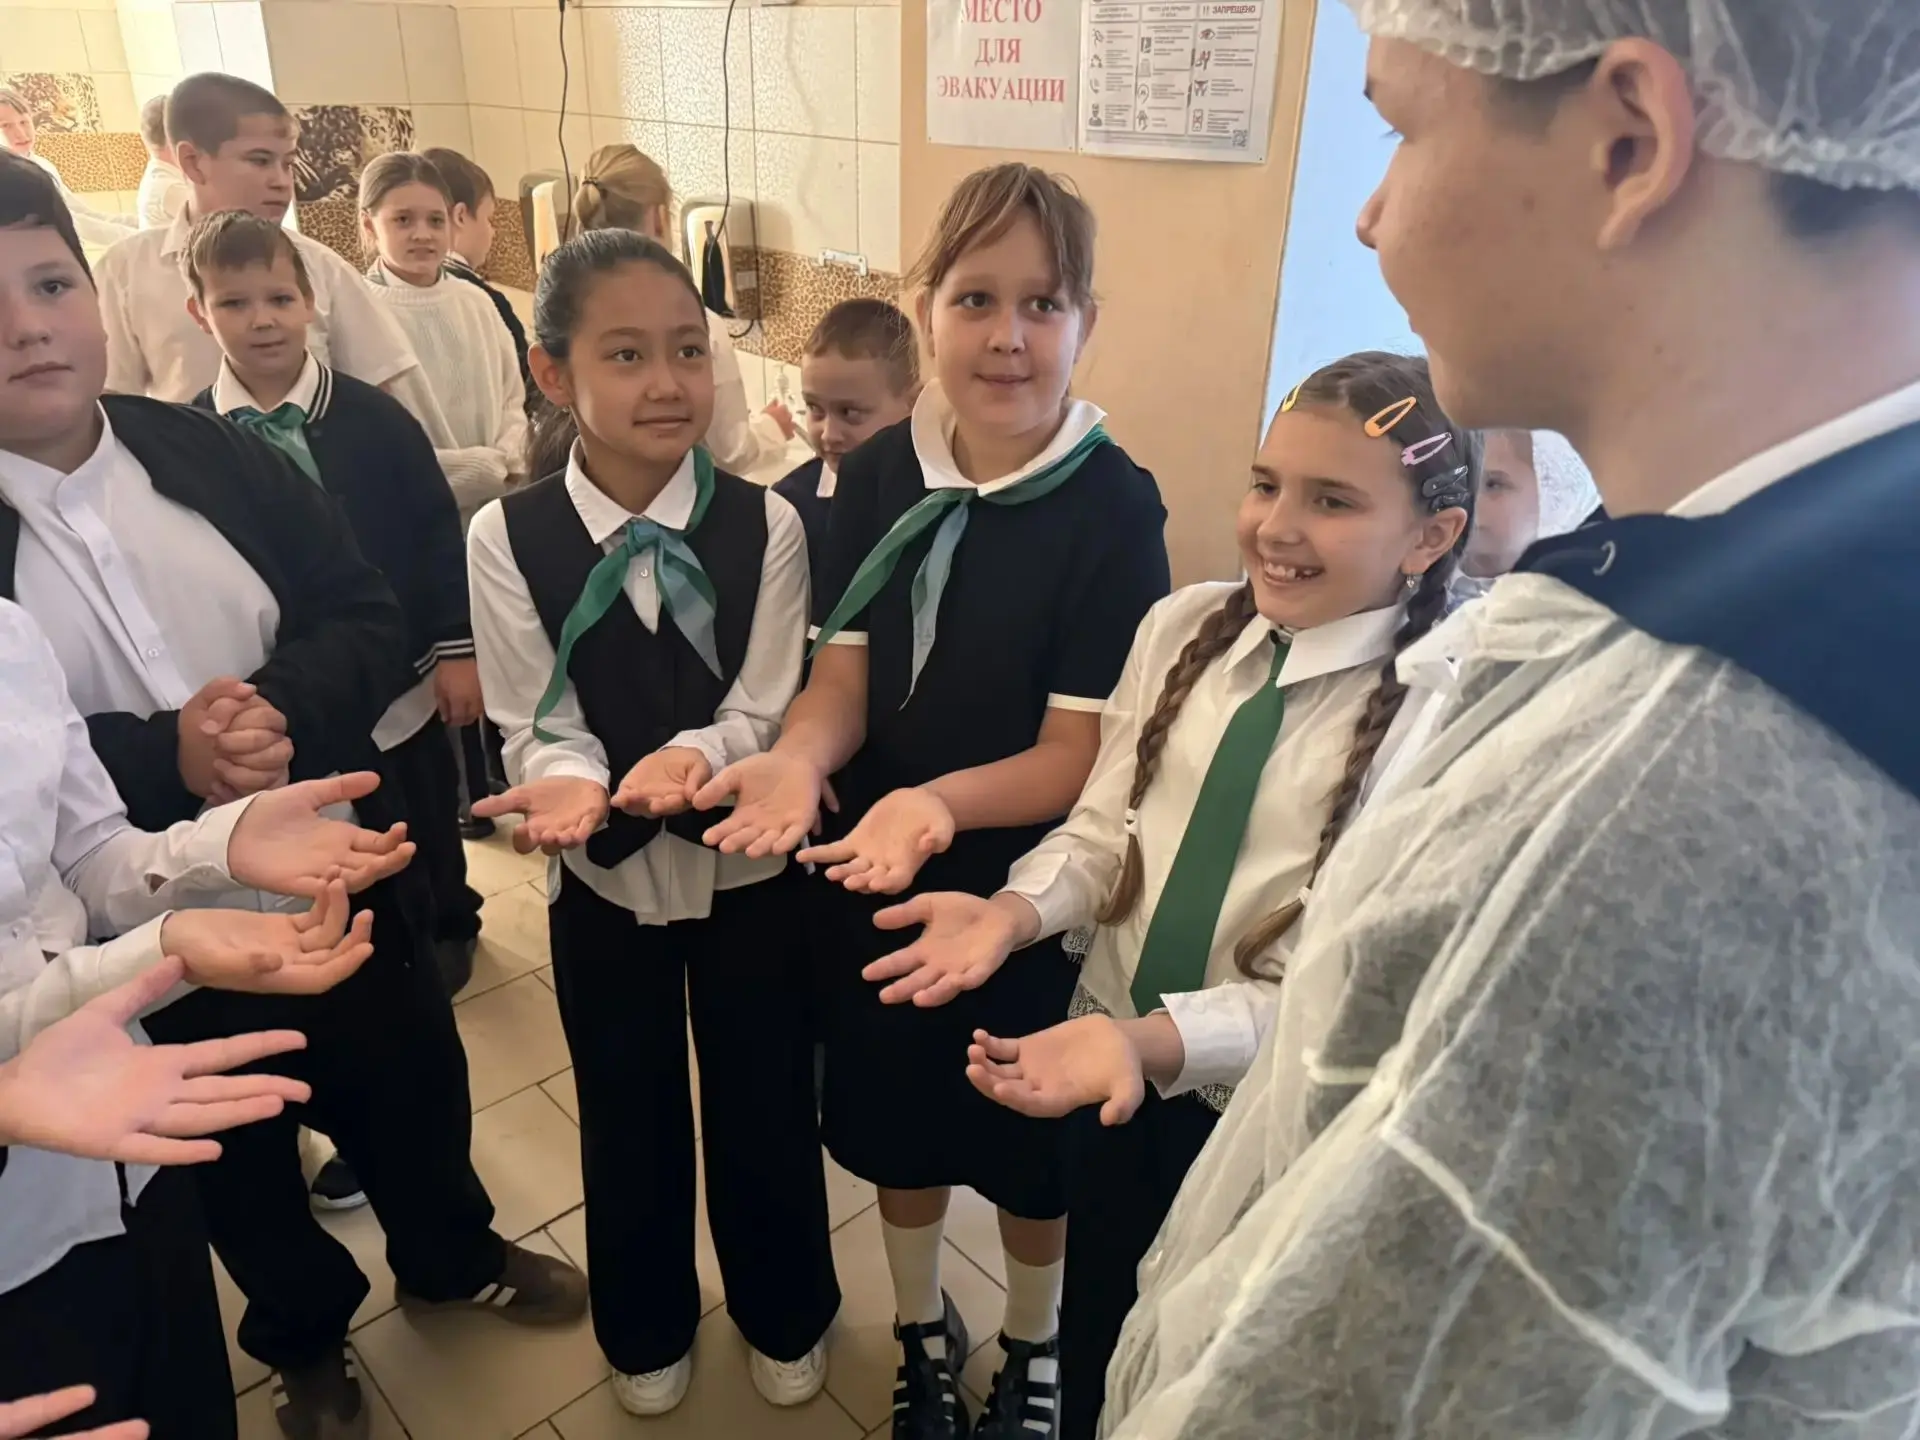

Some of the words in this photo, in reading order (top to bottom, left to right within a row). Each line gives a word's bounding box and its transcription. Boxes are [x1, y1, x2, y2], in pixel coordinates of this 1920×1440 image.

[960, 0, 1041, 23] МЕСТО
[1212, 4, 1256, 14] ЗАПРЕЩЕНО
[974, 38, 1022, 67] ДЛЯ
[937, 75, 1065, 106] ЭВАКУАЦИИ
